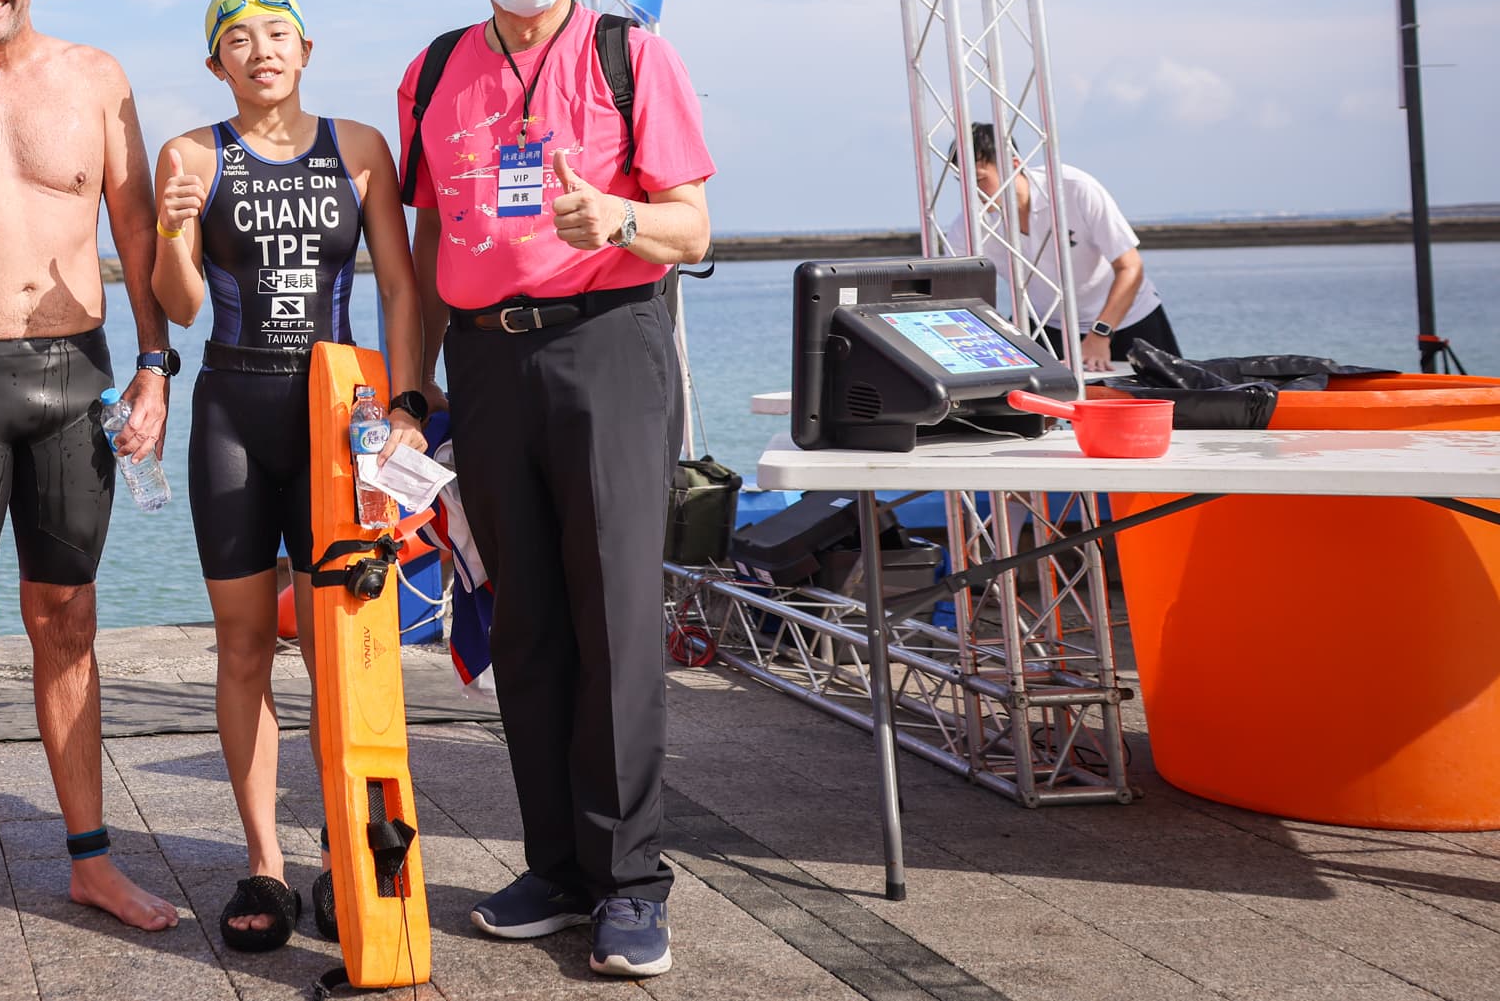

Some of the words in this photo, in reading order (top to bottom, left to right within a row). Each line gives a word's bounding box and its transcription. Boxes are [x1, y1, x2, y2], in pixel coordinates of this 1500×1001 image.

[252, 176, 304, 194] RACE
[310, 175, 338, 190] ON
[513, 174, 530, 183] VIP
[233, 195, 340, 232] CHANG
[254, 233, 323, 267] TPE
[283, 273, 314, 289] 長庚
[266, 333, 309, 344] TAIWAN
[363, 625, 372, 670] ATUNAS
